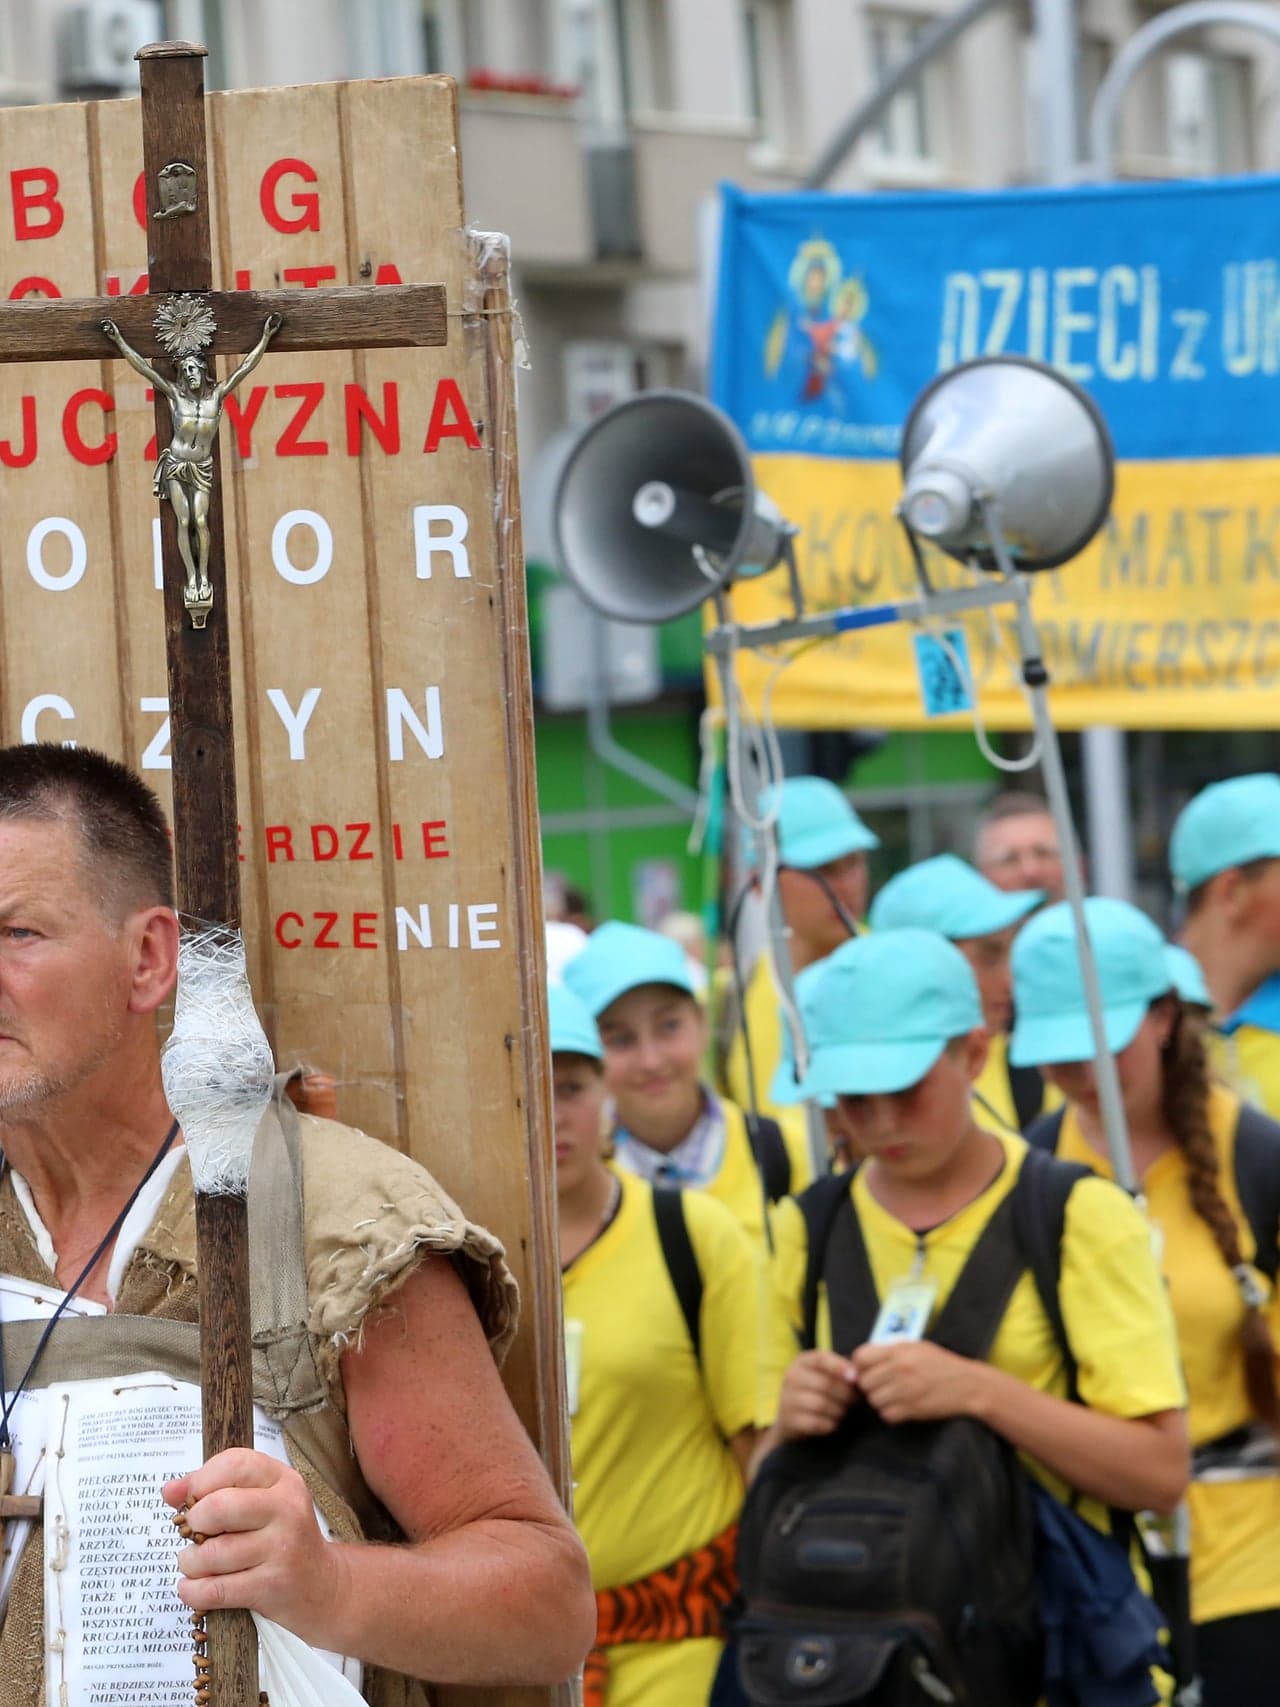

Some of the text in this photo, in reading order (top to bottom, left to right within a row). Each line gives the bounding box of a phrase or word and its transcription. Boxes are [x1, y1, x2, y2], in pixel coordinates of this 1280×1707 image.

[9, 158, 320, 241] BG
[78, 1471, 190, 1487] PIELGRZYMKA EKS
[80, 1499, 120, 1512] TRÓJCY
[152, 1511, 176, 1521] WSZ
[79, 1525, 152, 1538] PROFANACJĘ
[80, 1563, 180, 1578] CZĘSTOCHOWSKI
[80, 1577, 176, 1591] ROKU) ORAZ JEJ
[81, 1589, 181, 1603] TAKŻE W INTEN
[81, 1604, 137, 1617] SŁOWACJI
[82, 1617, 154, 1630] WSZYSTKICH
[82, 1630, 140, 1643] KRUCJATA
[83, 1644, 140, 1656] KRUCJATA
[90, 1681, 107, 1691] NIE
[109, 1680, 156, 1691] BĘDZIESZ
[89, 1693, 137, 1704] IMIENIA
[139, 1691, 168, 1702] PANA
